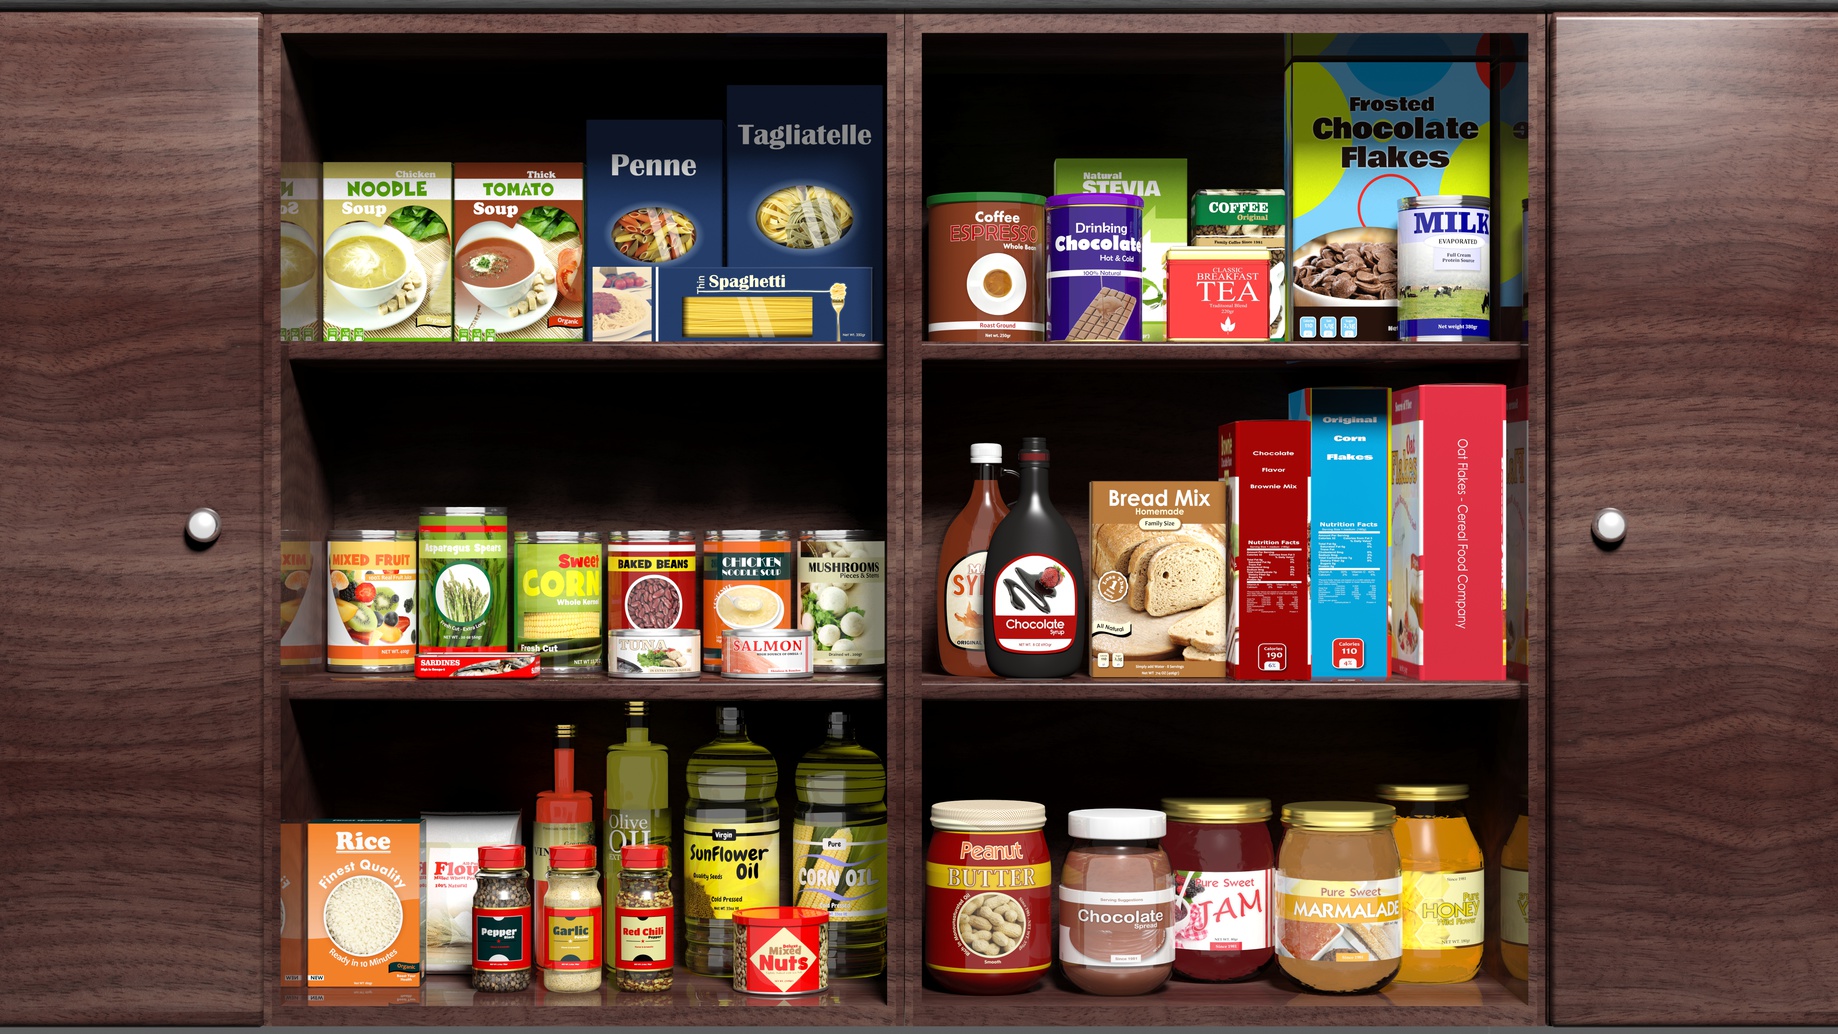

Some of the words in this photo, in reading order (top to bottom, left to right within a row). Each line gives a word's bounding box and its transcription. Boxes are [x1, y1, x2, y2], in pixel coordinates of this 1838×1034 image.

[1350, 97, 1435, 112] Frosted
[1312, 117, 1479, 140] Chocolate
[738, 124, 872, 150] Tagliatelle
[611, 154, 697, 176] Penne
[1341, 146, 1450, 169] Flakes
[395, 170, 436, 179] Chicken
[527, 170, 556, 179] Thick
[1083, 172, 1122, 180] Natural
[347, 181, 427, 197] NOODLE
[483, 182, 554, 196] TOMATO
[1082, 180, 1161, 196] STEVIA
[342, 202, 387, 217] Soup
[473, 202, 518, 217] Soup
[1208, 202, 1269, 214] COFFEE
[975, 210, 1020, 223] Coffee
[1237, 214, 1268, 222] Original
[1413, 211, 1490, 235] MILK
[950, 224, 1038, 243] ESPRESSO
[1075, 222, 1128, 236] Drinking
[1055, 235, 1142, 253] Chocolate
[709, 274, 786, 290] Spaghetti
[1196, 272, 1259, 281] BREAKFAST
[697, 275, 705, 294] Thin
[1196, 281, 1260, 302] TEA
[425, 316, 447, 324] Organic
[557, 317, 579, 325] Organic
[1322, 416, 1378, 425] Original
[1457, 438, 1469, 460] Oat
[1326, 453, 1373, 461] Flakes
[1457, 462, 1469, 495] Flakes
[1109, 489, 1167, 507] Bread
[1174, 489, 1211, 507] Mix
[1135, 508, 1185, 516] Homemade
[1457, 504, 1469, 541] Cereal
[424, 544, 471, 555] Asparagus
[474, 543, 502, 553] Spears
[332, 554, 370, 566] MIXED
[375, 554, 410, 566] FRUIT
[558, 553, 599, 569] Sweet
[618, 559, 652, 569] BAKED
[656, 559, 689, 569] BEANS
[722, 557, 782, 568] CHICKEN
[1457, 544, 1469, 572] Food
[808, 562, 880, 572] MUSHROOMS
[522, 569, 600, 597] CORN
[1455, 574, 1469, 629] Company
[1006, 619, 1065, 629] Chocolate
[1105, 624, 1125, 632] Natural
[520, 644, 540, 652] Fresh
[542, 644, 558, 652] Cut
[618, 638, 668, 651] TUNA
[733, 640, 803, 652] SALMON
[1266, 652, 1283, 660] 190
[608, 813, 648, 830] Olive
[335, 831, 391, 850] Rice
[715, 831, 733, 840] Virgin
[690, 843, 769, 862] SunFlower
[960, 841, 1024, 860] Peanut
[318, 861, 356, 890] Finest
[359, 859, 406, 890] Quality
[434, 861, 479, 876] Flou
[736, 862, 759, 880] Oil
[693, 872, 709, 881] Quality
[798, 867, 840, 887] CORN
[845, 868, 879, 887] OIL
[948, 868, 1036, 888] BUTTER
[1195, 877, 1219, 888] Pure
[1223, 878, 1255, 888] Sweet
[1321, 887, 1345, 897] Pure
[1350, 887, 1382, 897] Sweet
[1462, 892, 1479, 901] Pure
[1078, 908, 1164, 923] Chocolate
[1193, 888, 1262, 931] JAM
[1293, 900, 1399, 919] MARMALADE
[1422, 900, 1480, 918] HONEY
[1134, 922, 1158, 930] Spread
[1456, 917, 1476, 925] Flower
[481, 928, 517, 937] Pepper
[553, 926, 589, 936] Garlic
[623, 927, 640, 936] Red
[642, 926, 664, 936] Chili
[328, 948, 351, 967] Ready
[351, 958, 359, 967] in
[369, 948, 398, 967] Minutes
[769, 945, 802, 955] Mixed
[759, 954, 809, 971] Nuts
